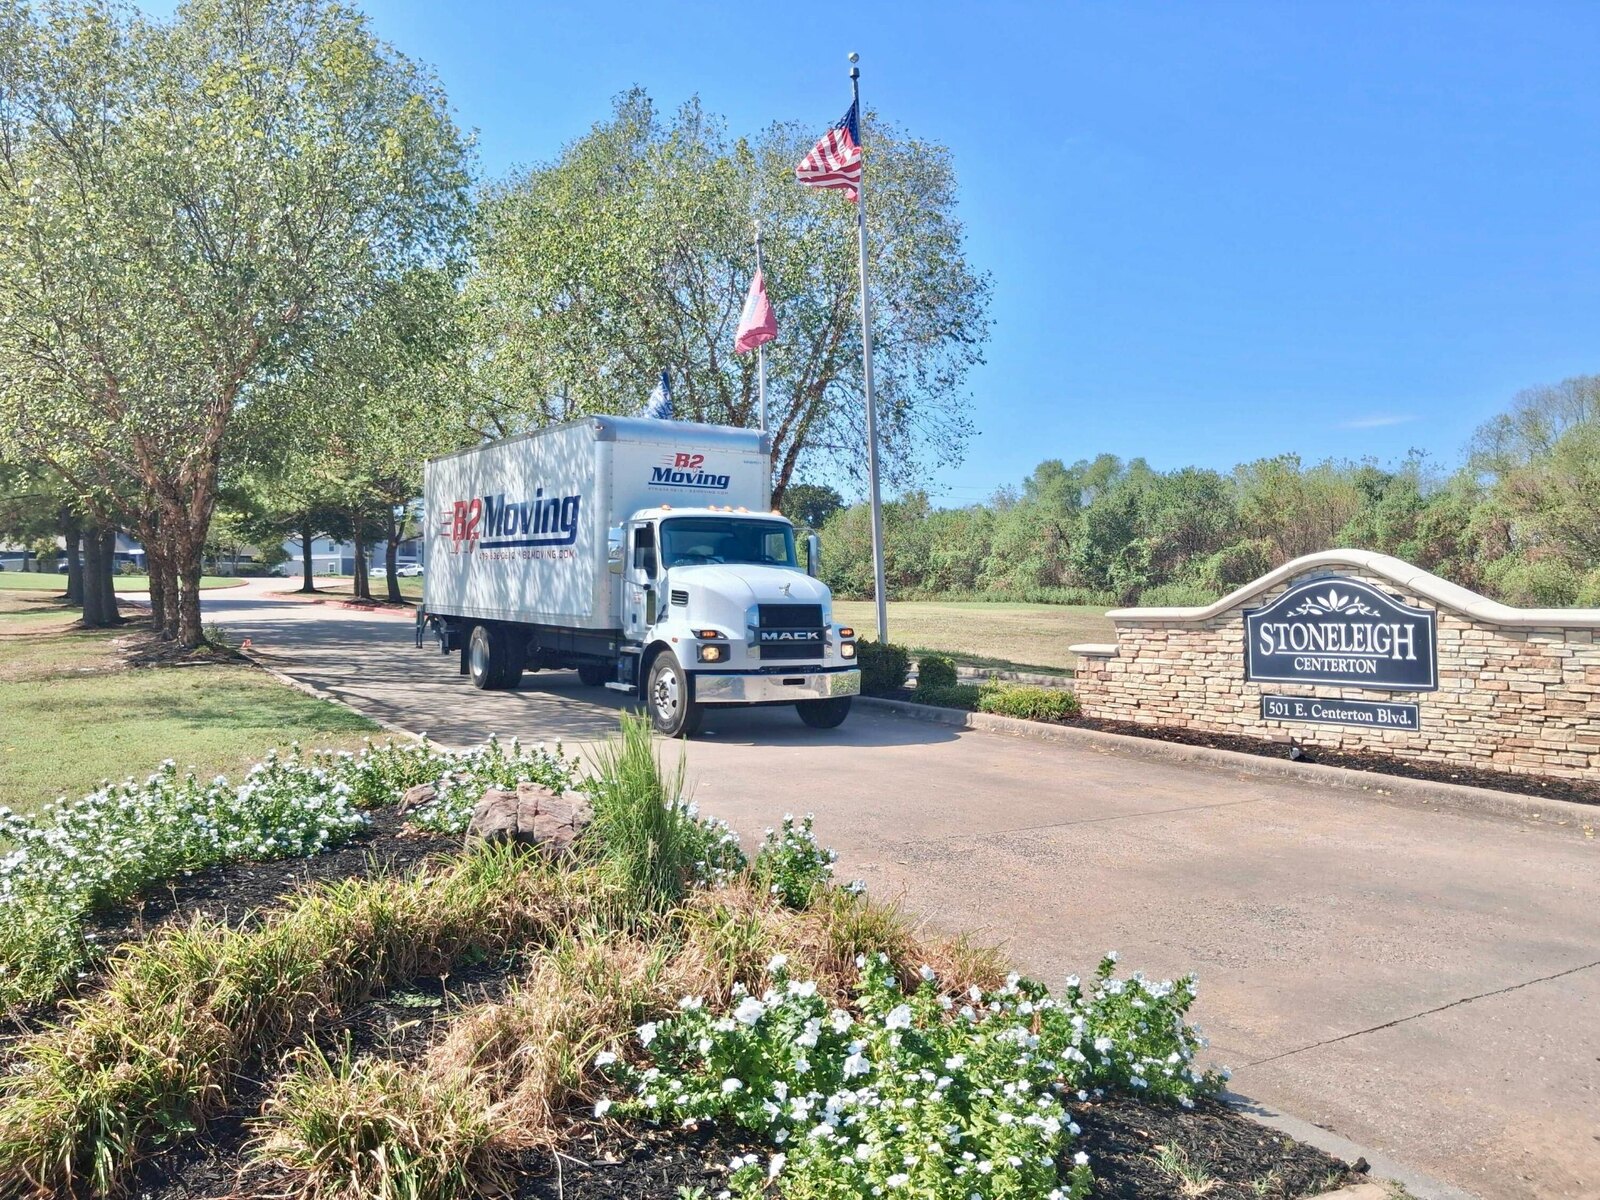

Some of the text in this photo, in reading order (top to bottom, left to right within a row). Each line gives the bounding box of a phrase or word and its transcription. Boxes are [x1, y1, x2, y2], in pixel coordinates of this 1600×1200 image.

[675, 453, 705, 469] B2
[649, 467, 731, 490] Moving
[452, 487, 581, 548] B2 Moving
[761, 632, 820, 640] MACK
[1259, 622, 1418, 661] STONELEIGH
[1294, 656, 1377, 674] CENTERTON
[1268, 701, 1412, 725] 501 E. Centerton Blvd.
